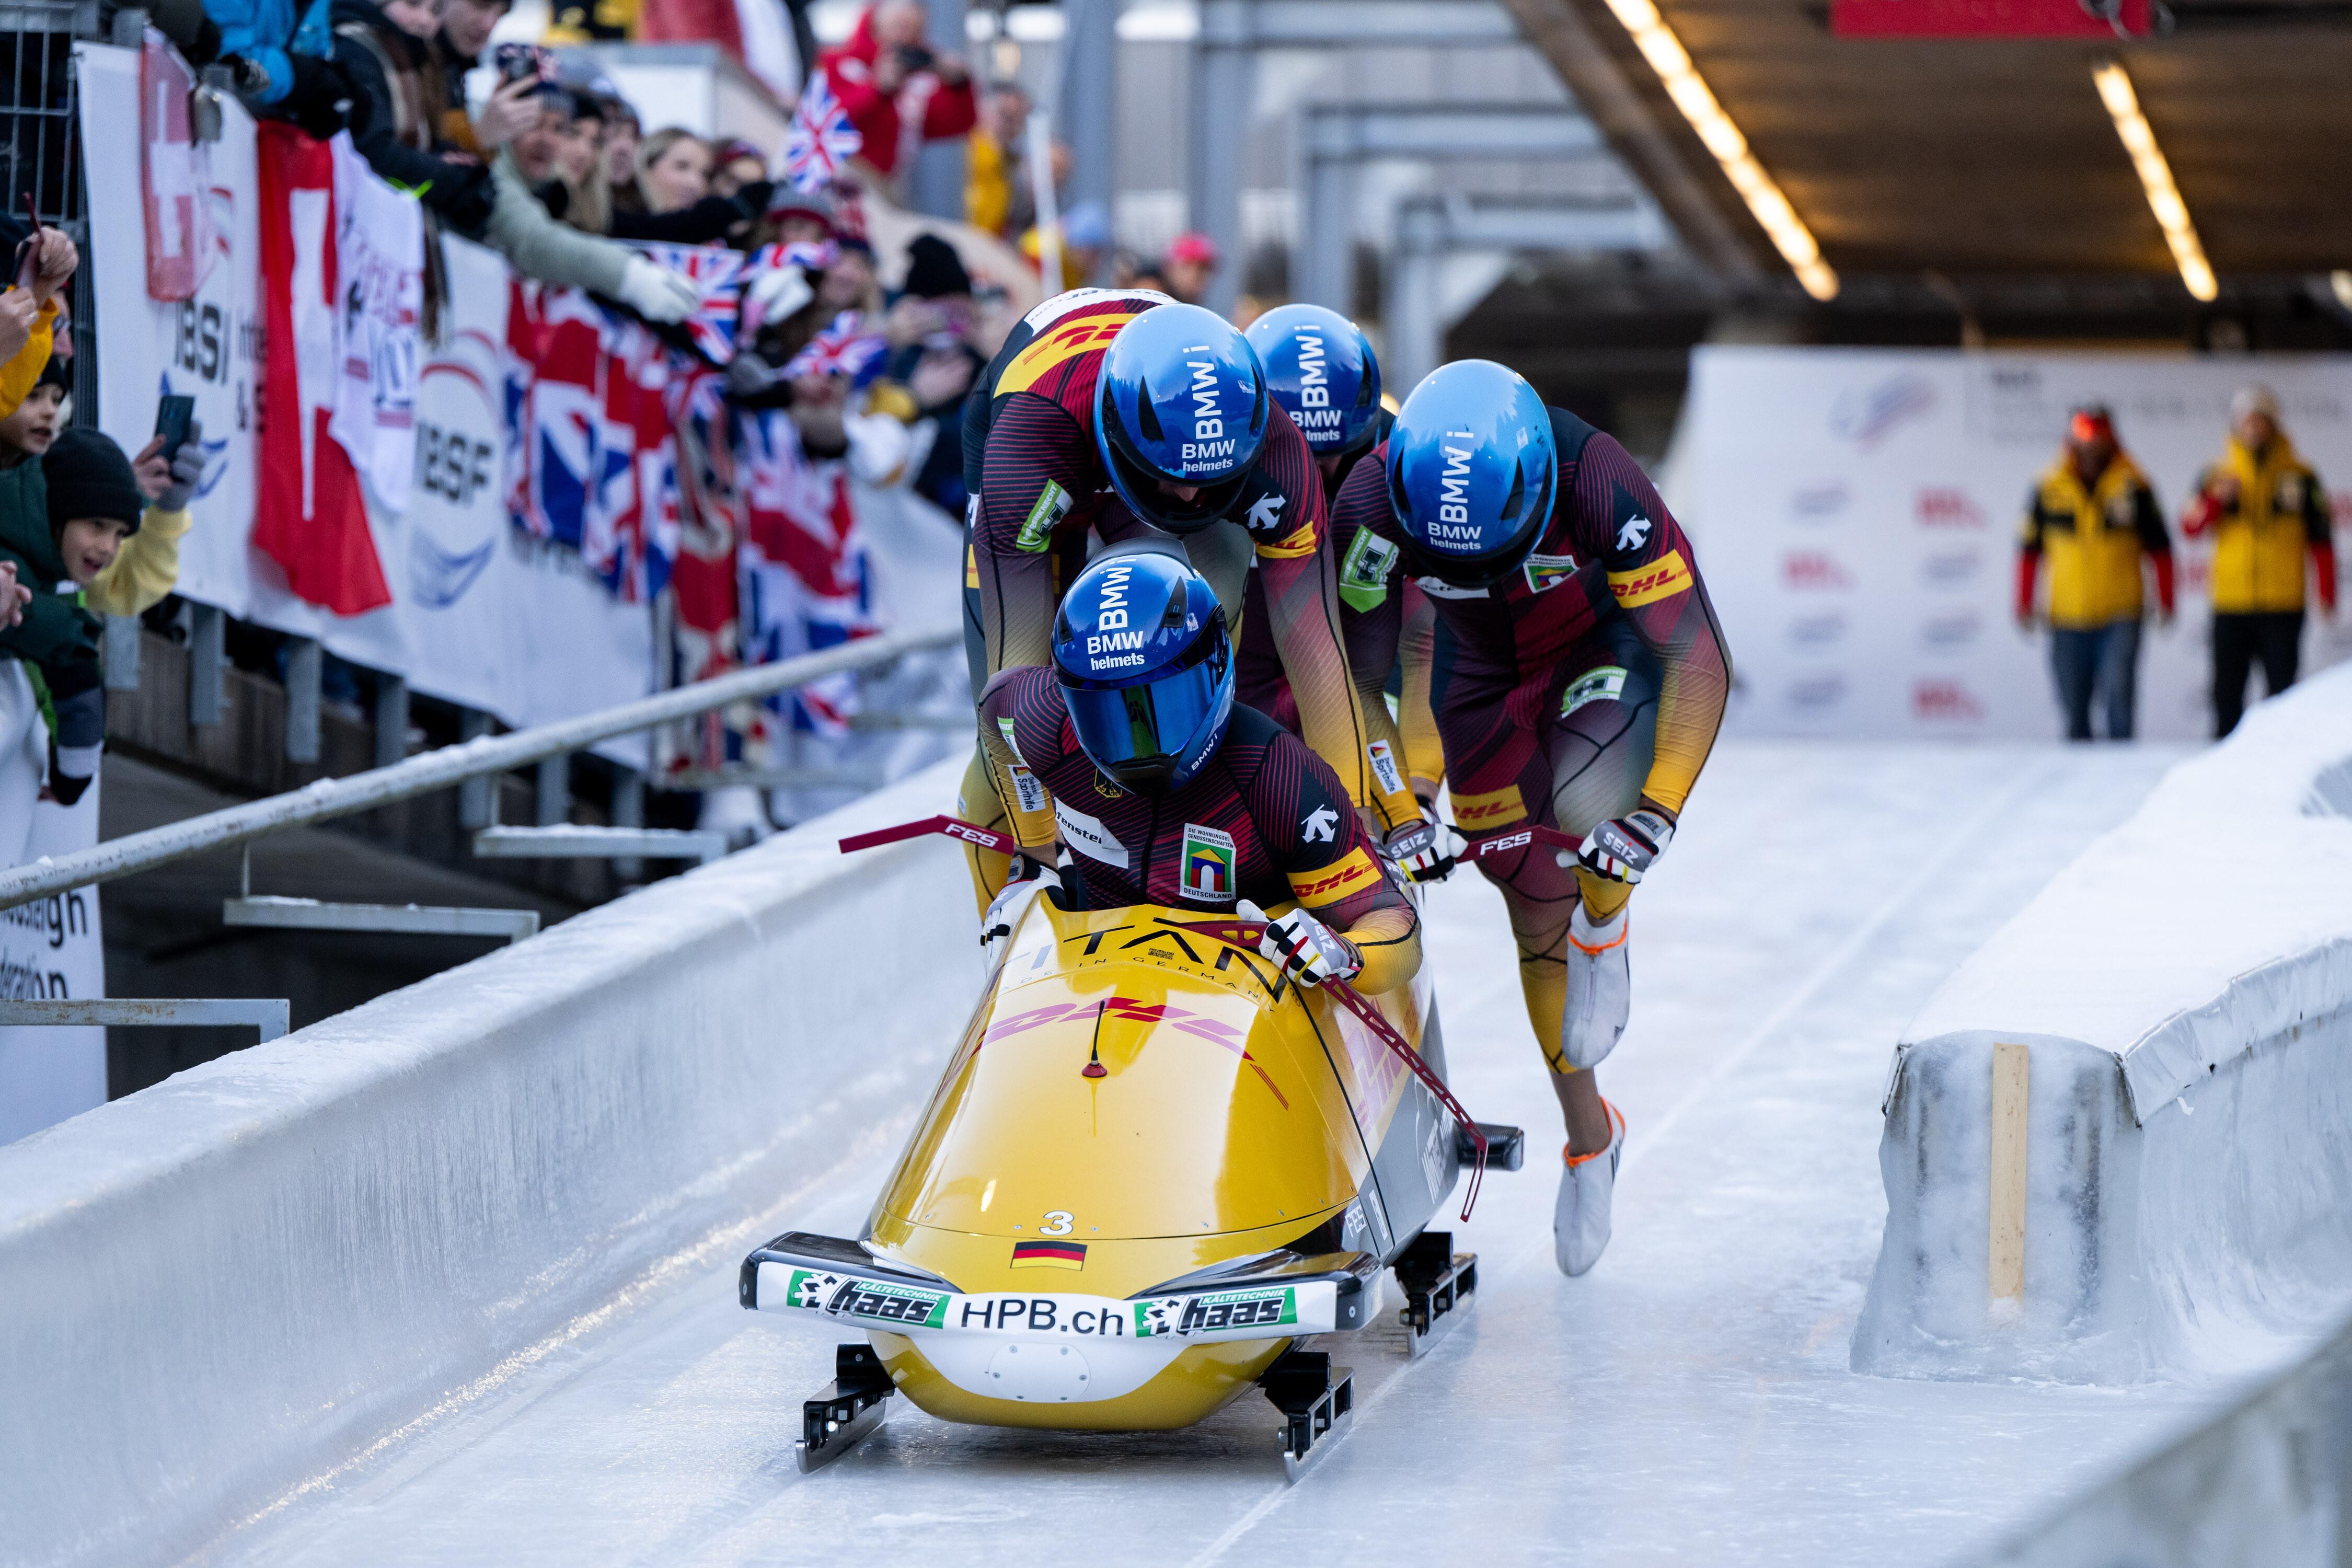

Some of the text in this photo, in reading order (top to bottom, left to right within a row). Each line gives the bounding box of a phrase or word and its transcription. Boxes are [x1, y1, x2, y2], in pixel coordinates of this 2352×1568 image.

[174, 297, 230, 386] IBS
[1295, 335, 1329, 408] BMW
[1186, 362, 1223, 440] BMW
[1289, 410, 1342, 428] BMW
[1182, 439, 1236, 459] BMW
[1303, 430, 1341, 442] lmets
[1182, 458, 1233, 472] helmets
[1440, 446, 1471, 523] BMW
[1428, 522, 1481, 540] BMW
[1430, 537, 1481, 550] helmets
[1609, 569, 1677, 597] DHL
[1099, 567, 1133, 631] BMW
[1087, 631, 1144, 654] BMW
[1091, 653, 1145, 671] helmets
[1192, 739, 1214, 770] BMW
[945, 823, 999, 848] FES
[1187, 834, 1233, 848] GENOSSENSCHAFTEN
[1197, 829, 1229, 841] WOHNUNGSB
[1391, 832, 1427, 858] SEIZ
[1480, 831, 1531, 856] FES
[1603, 832, 1639, 865] SEIZ
[1184, 887, 1232, 898] DEUTSCHLAND
[1293, 864, 1363, 897] DHL
[987, 925, 1288, 1004] TITAN
[1078, 958, 1106, 967] IN
[1133, 956, 1274, 1012] GERMANY
[971, 997, 1255, 1062] DHL
[1039, 1210, 1075, 1236] 3
[1345, 1204, 1367, 1238] FES
[827, 1278, 938, 1324] haas
[859, 1281, 945, 1302] KÄLTETECHNIK
[1202, 1288, 1287, 1305] KÄLTETECHNIK
[961, 1299, 1124, 1336] HPB.ch
[1179, 1296, 1285, 1332] haas
